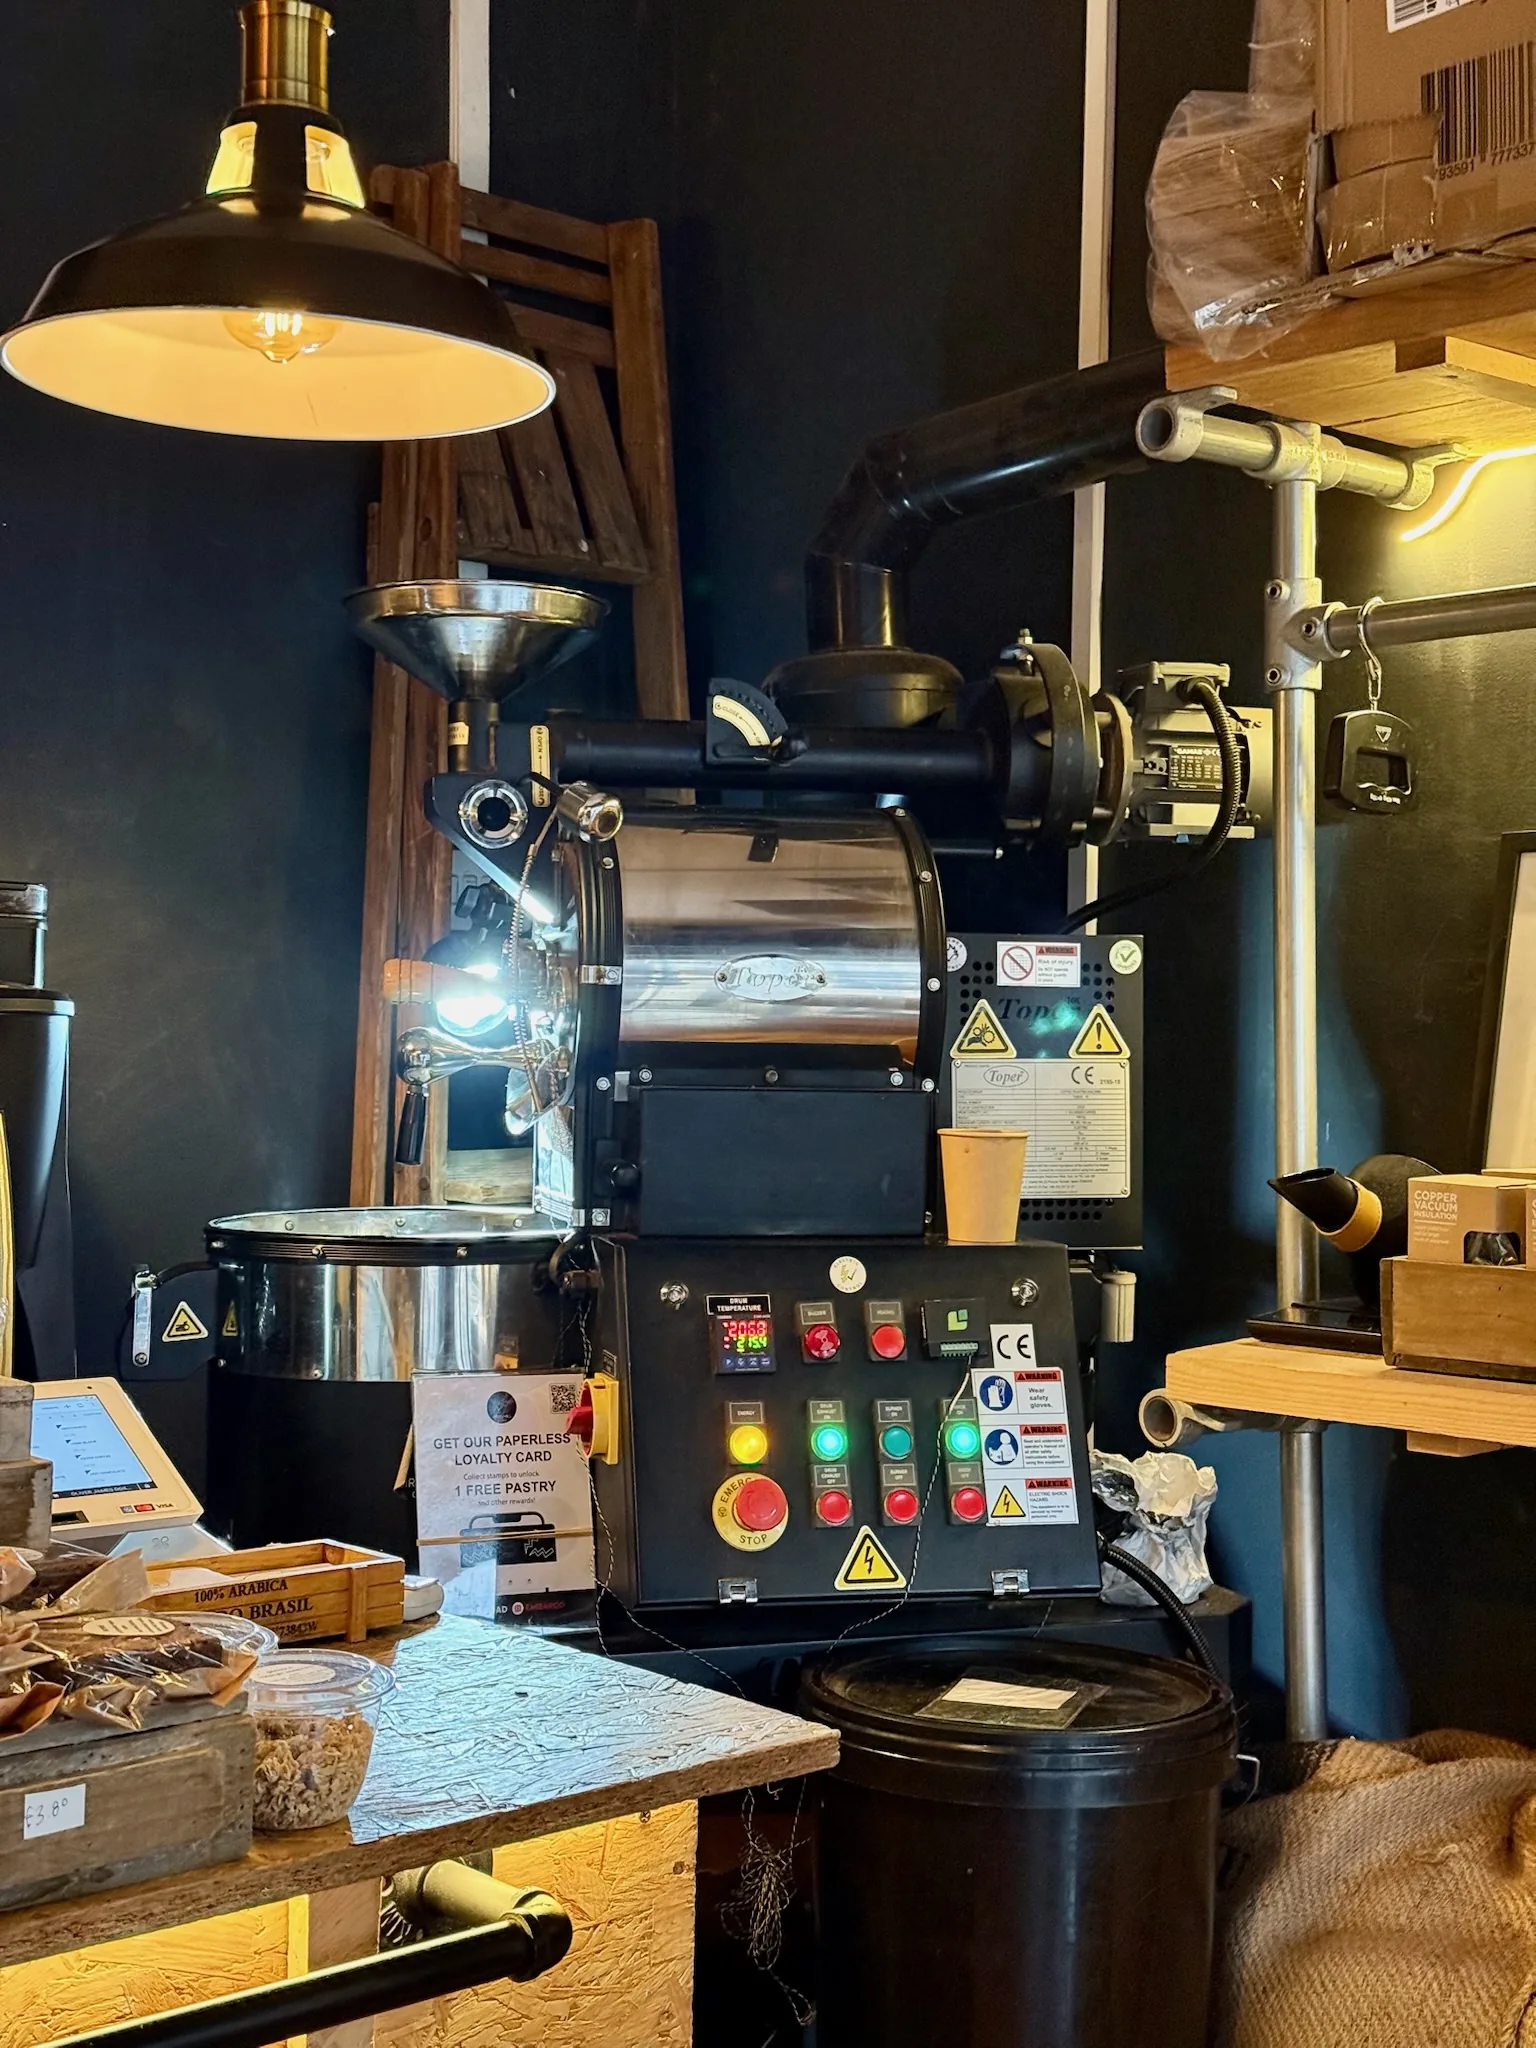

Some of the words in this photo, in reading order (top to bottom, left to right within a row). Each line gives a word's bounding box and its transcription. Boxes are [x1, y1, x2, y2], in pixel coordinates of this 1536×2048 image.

[990, 1070, 1023, 1085] Toper
[1414, 1190, 1457, 1203] COPPER
[1414, 1200, 1458, 1213] VACUUM
[1413, 1210, 1458, 1221] INSULATION
[717, 1304, 762, 1312] TEMPERATURE
[1029, 1394, 1049, 1402] safety
[1030, 1426, 1063, 1434] WARNING
[433, 1438, 460, 1450] GET
[463, 1436, 492, 1448] OUR
[496, 1433, 571, 1447] PAPERLESS
[455, 1452, 512, 1466] LOYALTY
[515, 1450, 552, 1463] CARD
[463, 1472, 486, 1481] Collect
[486, 1471, 509, 1480] stamps
[518, 1470, 540, 1478] unlock
[455, 1485, 461, 1497] 1
[466, 1483, 501, 1496] FREE
[505, 1480, 556, 1494] PASTRY
[1036, 1479, 1069, 1487] WARNING
[490, 1498, 509, 1506] other
[509, 1497, 536, 1505] rewards!
[739, 1533, 768, 1545] STOP
[194, 1589, 225, 1603] 100%
[229, 1578, 289, 1598] ARABICA
[250, 1598, 313, 1620] BRASIL
